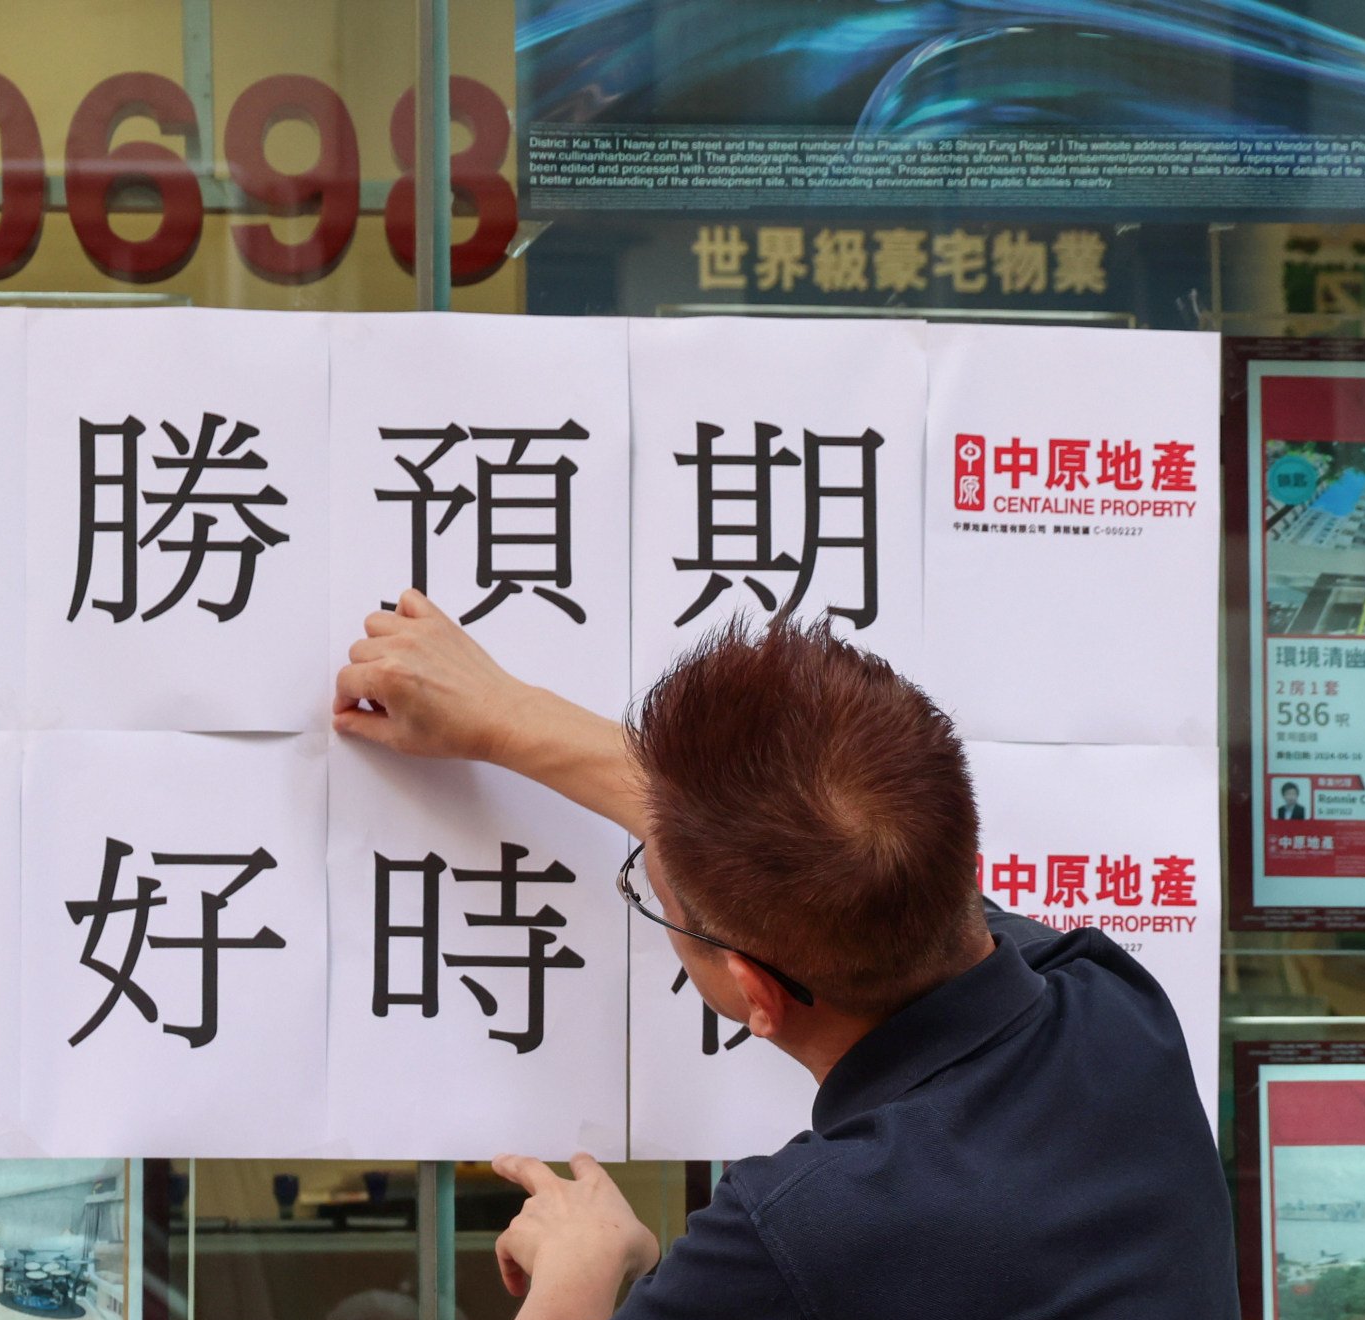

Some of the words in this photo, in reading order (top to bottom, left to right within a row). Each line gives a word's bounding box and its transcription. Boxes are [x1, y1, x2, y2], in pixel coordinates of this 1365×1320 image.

[572, 138, 590, 149] Kai
[594, 138, 612, 149] Tak
[623, 139, 655, 150] Name
[671, 139, 689, 150] the
[691, 139, 722, 150] street
[705, 152, 727, 162] The
[561, 163, 595, 174] edited
[622, 164, 680, 176] processed
[540, 175, 572, 186] better
[575, 175, 654, 188] understanding
[691, 175, 764, 188] development
[691, 227, 1107, 294] 世界級豪宅物業
[994, 437, 1196, 492] 中原地產
[993, 496, 1094, 515] CENTALINE
[1100, 498, 1196, 518] PROPERTY
[1093, 526, 1143, 536] C-000227
[992, 853, 1197, 908] 中原地產
[1100, 915, 1197, 932] PROPERTY
